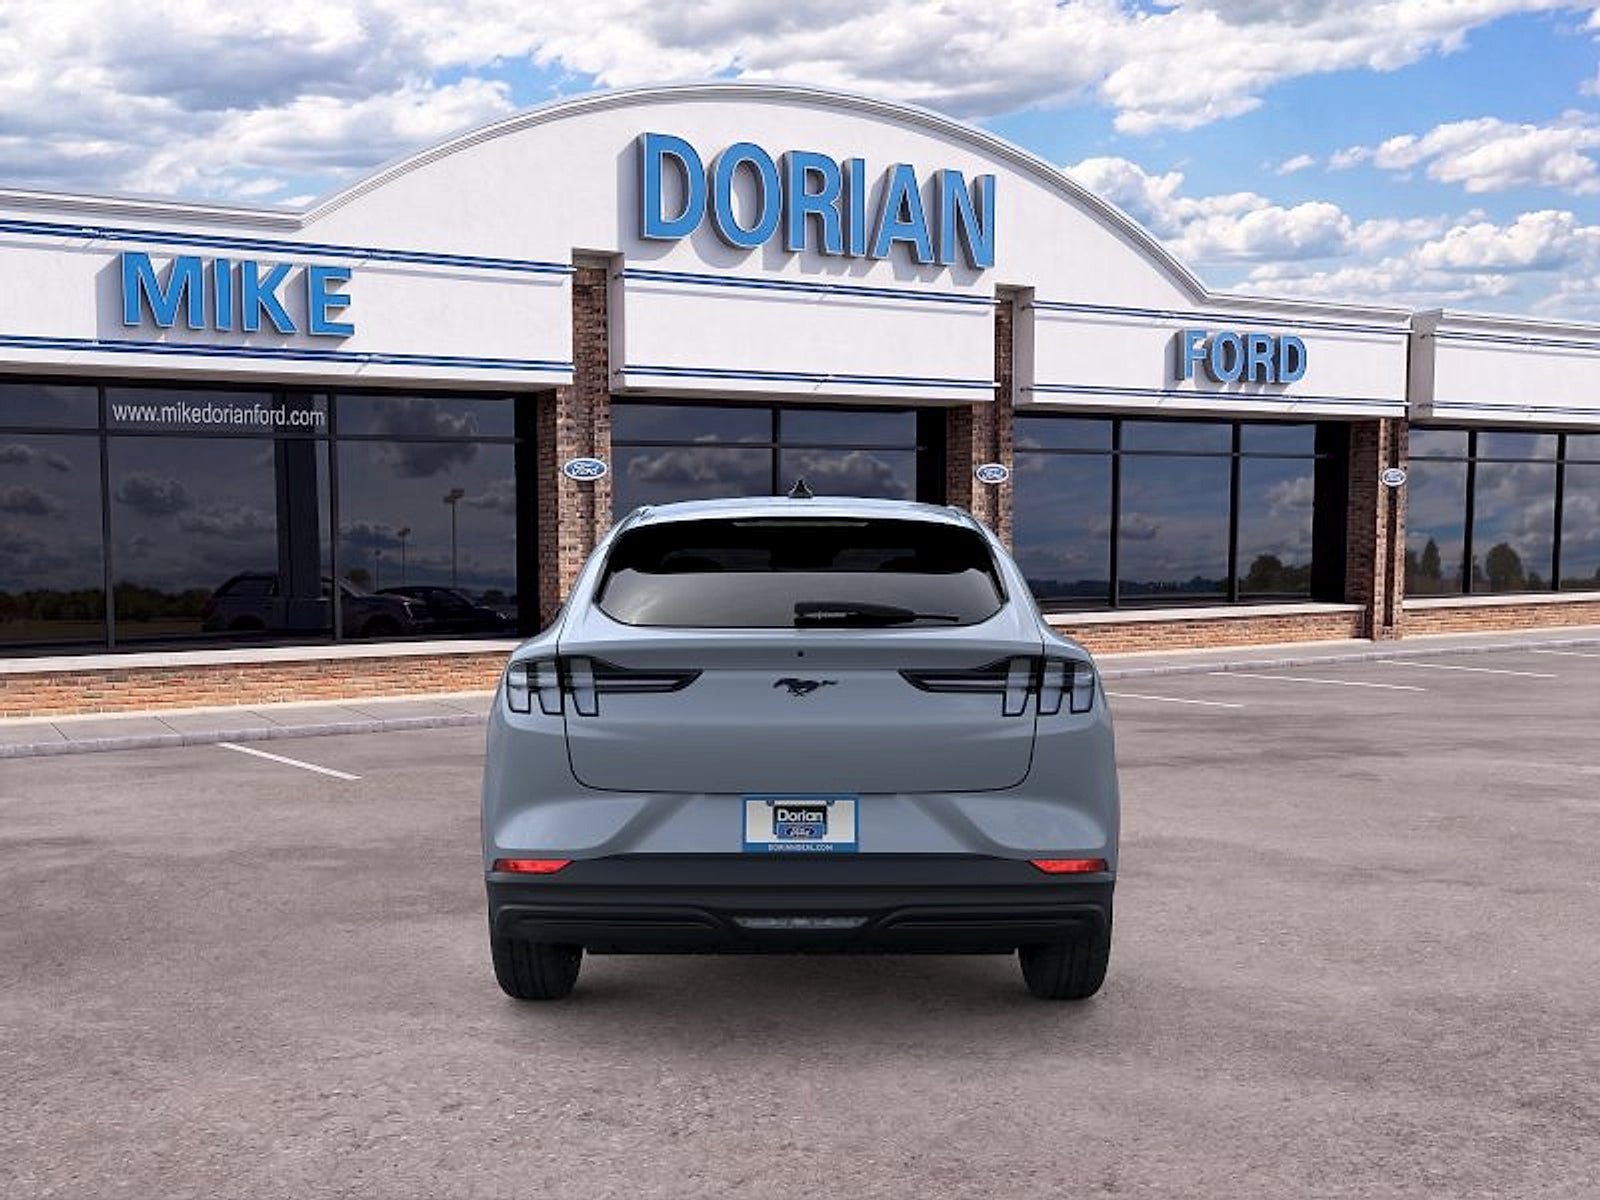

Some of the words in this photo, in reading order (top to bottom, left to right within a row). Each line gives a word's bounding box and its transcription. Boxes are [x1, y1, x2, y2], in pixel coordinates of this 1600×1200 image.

[639, 131, 995, 270] DORIAN
[120, 251, 355, 337] MIKE
[1176, 328, 1308, 384] FORD
[111, 402, 326, 426] www.mikedorianford.com
[777, 809, 824, 822] Dorian
